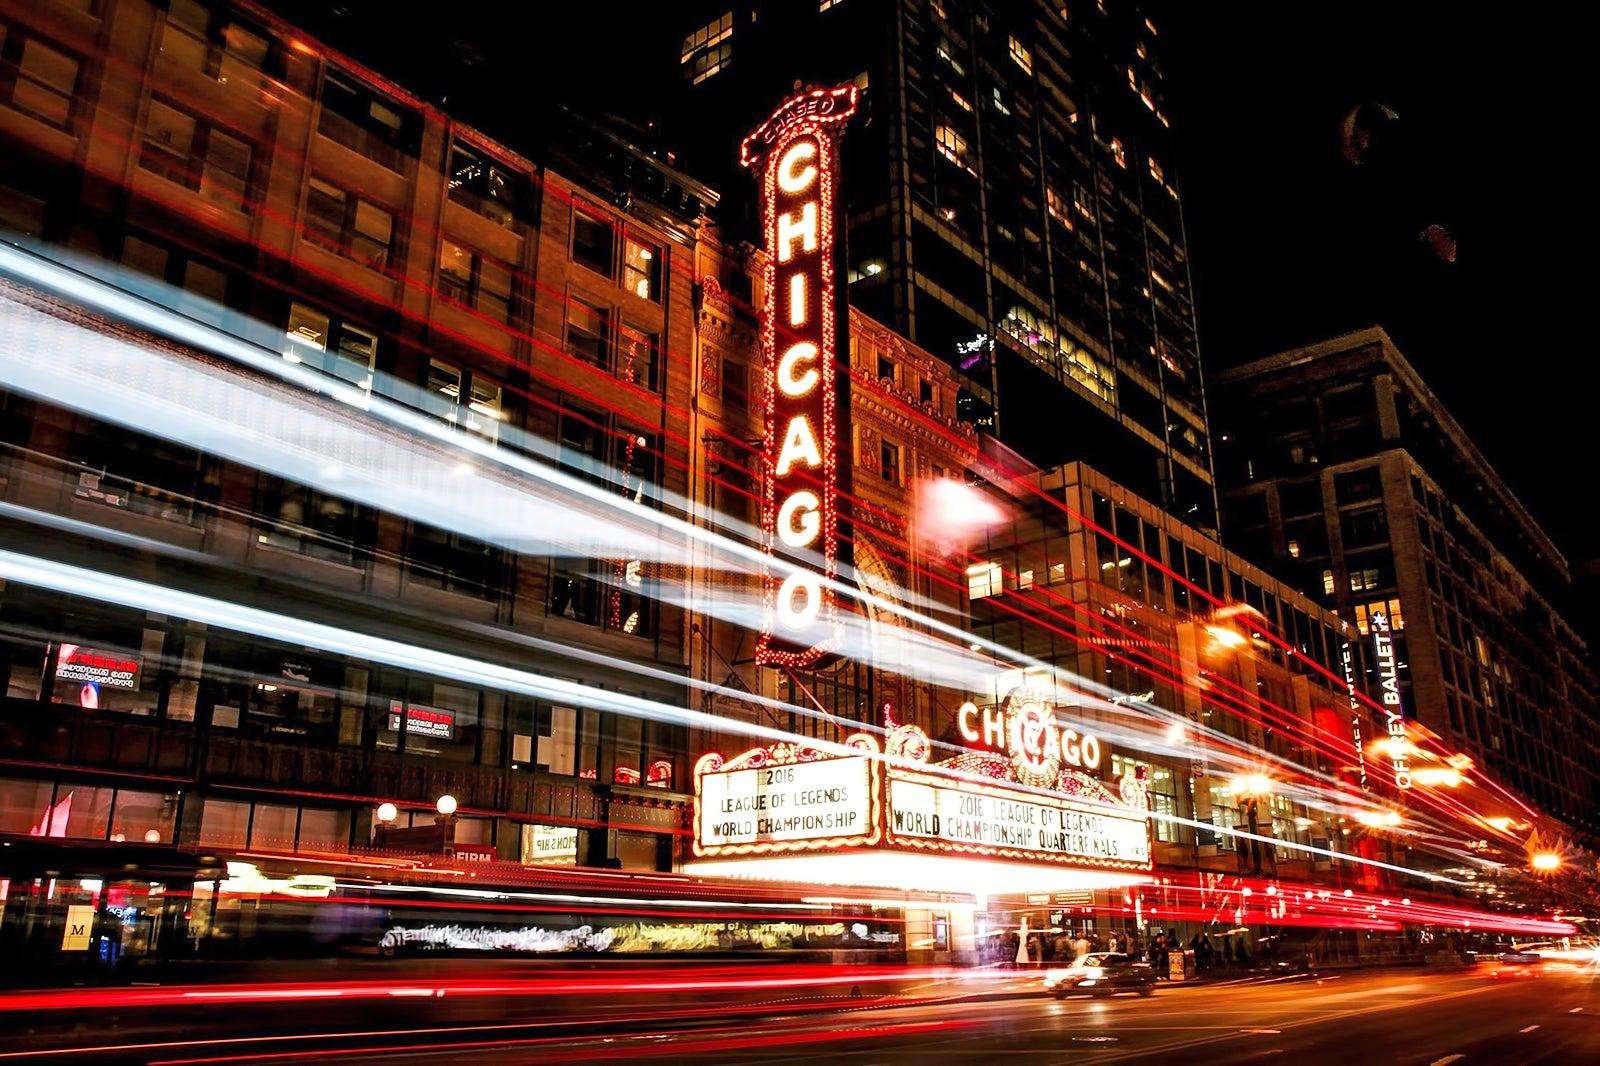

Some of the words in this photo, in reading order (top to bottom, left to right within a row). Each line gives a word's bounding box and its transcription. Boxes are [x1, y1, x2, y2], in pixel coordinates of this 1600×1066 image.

[776, 141, 822, 632] CHICAGO
[1375, 633, 1400, 705] BALLET
[959, 702, 1101, 769] CHGO
[766, 768, 795, 785] 2016
[721, 794, 767, 813] LEAGUE
[771, 793, 786, 808] OF
[794, 787, 849, 806] LEGENDS
[959, 795, 984, 817] 2016
[993, 800, 1035, 826] LEAGUE
[1041, 808, 1053, 826] OF
[1060, 811, 1104, 834] LEGENDS
[712, 821, 752, 837] WORLD
[757, 811, 857, 834] CHAMPIONSHIP
[894, 809, 940, 836] WORLD
[948, 817, 1032, 846] CHAMPIONSHIP
[1039, 829, 1118, 856] QUARTERFINALS
[456, 851, 491, 863] FIRM
[71, 924, 85, 936] M
